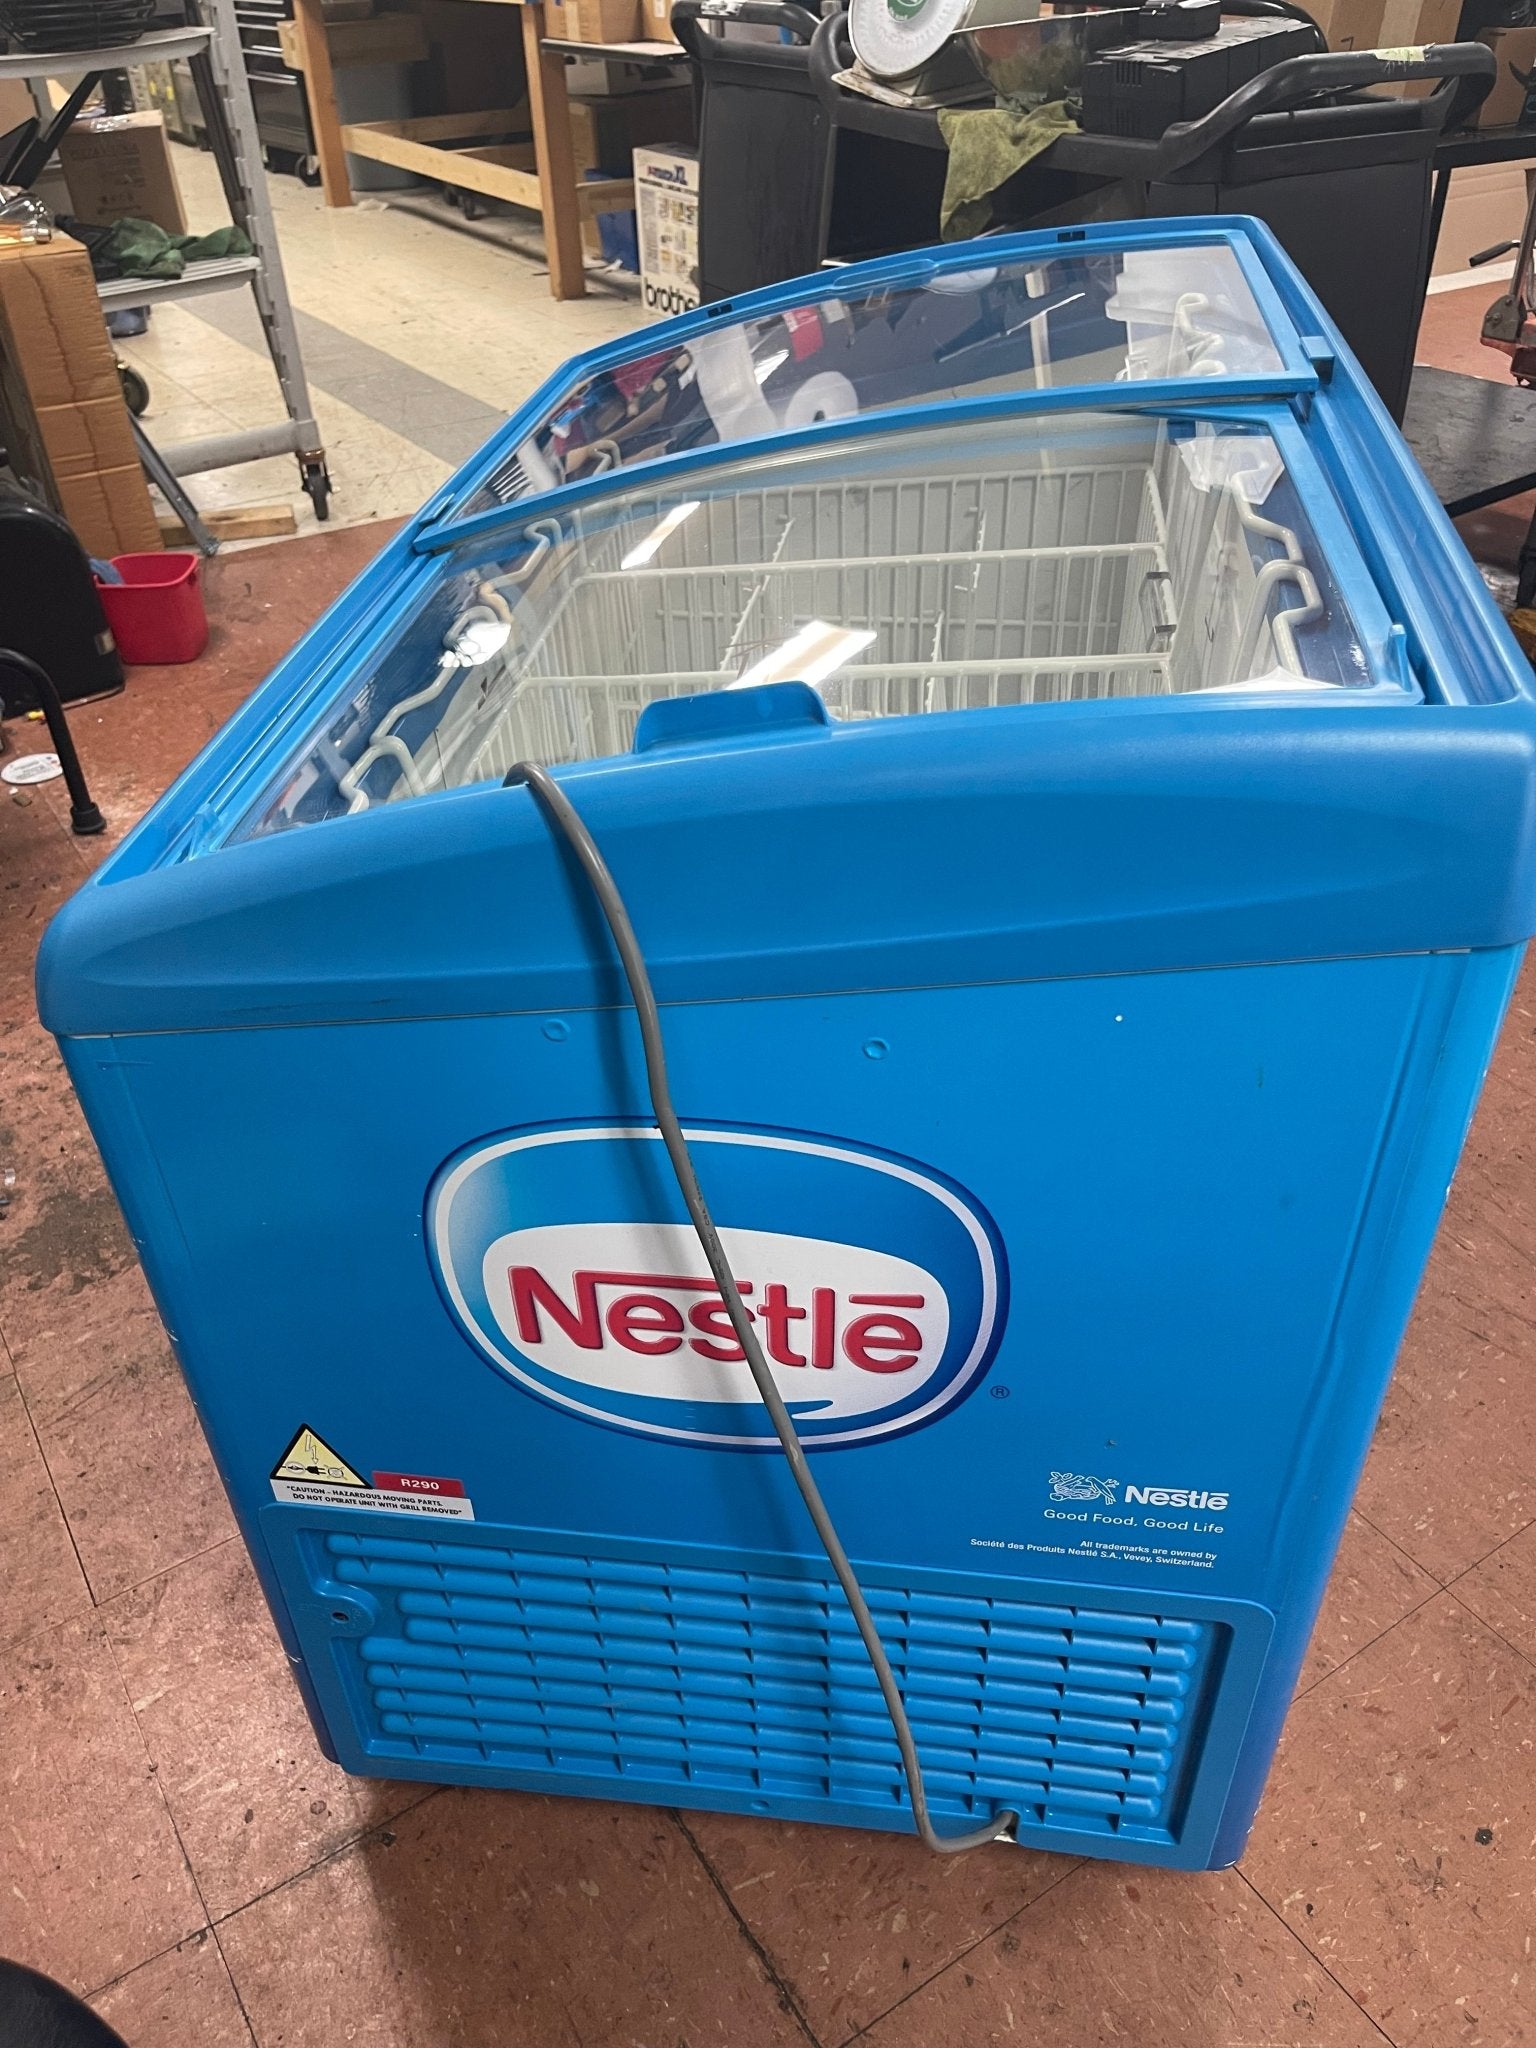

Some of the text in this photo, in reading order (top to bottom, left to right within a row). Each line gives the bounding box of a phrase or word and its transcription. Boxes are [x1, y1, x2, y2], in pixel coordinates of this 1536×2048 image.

[401, 1478, 440, 1490] R290
[325, 1496, 358, 1505] OPERATE
[359, 1499, 377, 1507] UNIT
[378, 1501, 398, 1509] WITH
[399, 1504, 421, 1512] GRILL
[332, 1489, 382, 1500] HAZARDOUS
[382, 1495, 416, 1504] MOVING
[1043, 1509, 1224, 1534] Good Food, Good Life
[970, 1538, 1005, 1548] Société
[1007, 1542, 1024, 1550] des
[1026, 1544, 1066, 1554] Produits
[1155, 1555, 1214, 1569] Switzerland.
[1080, 1540, 1218, 1562] All trademarks are owned by
